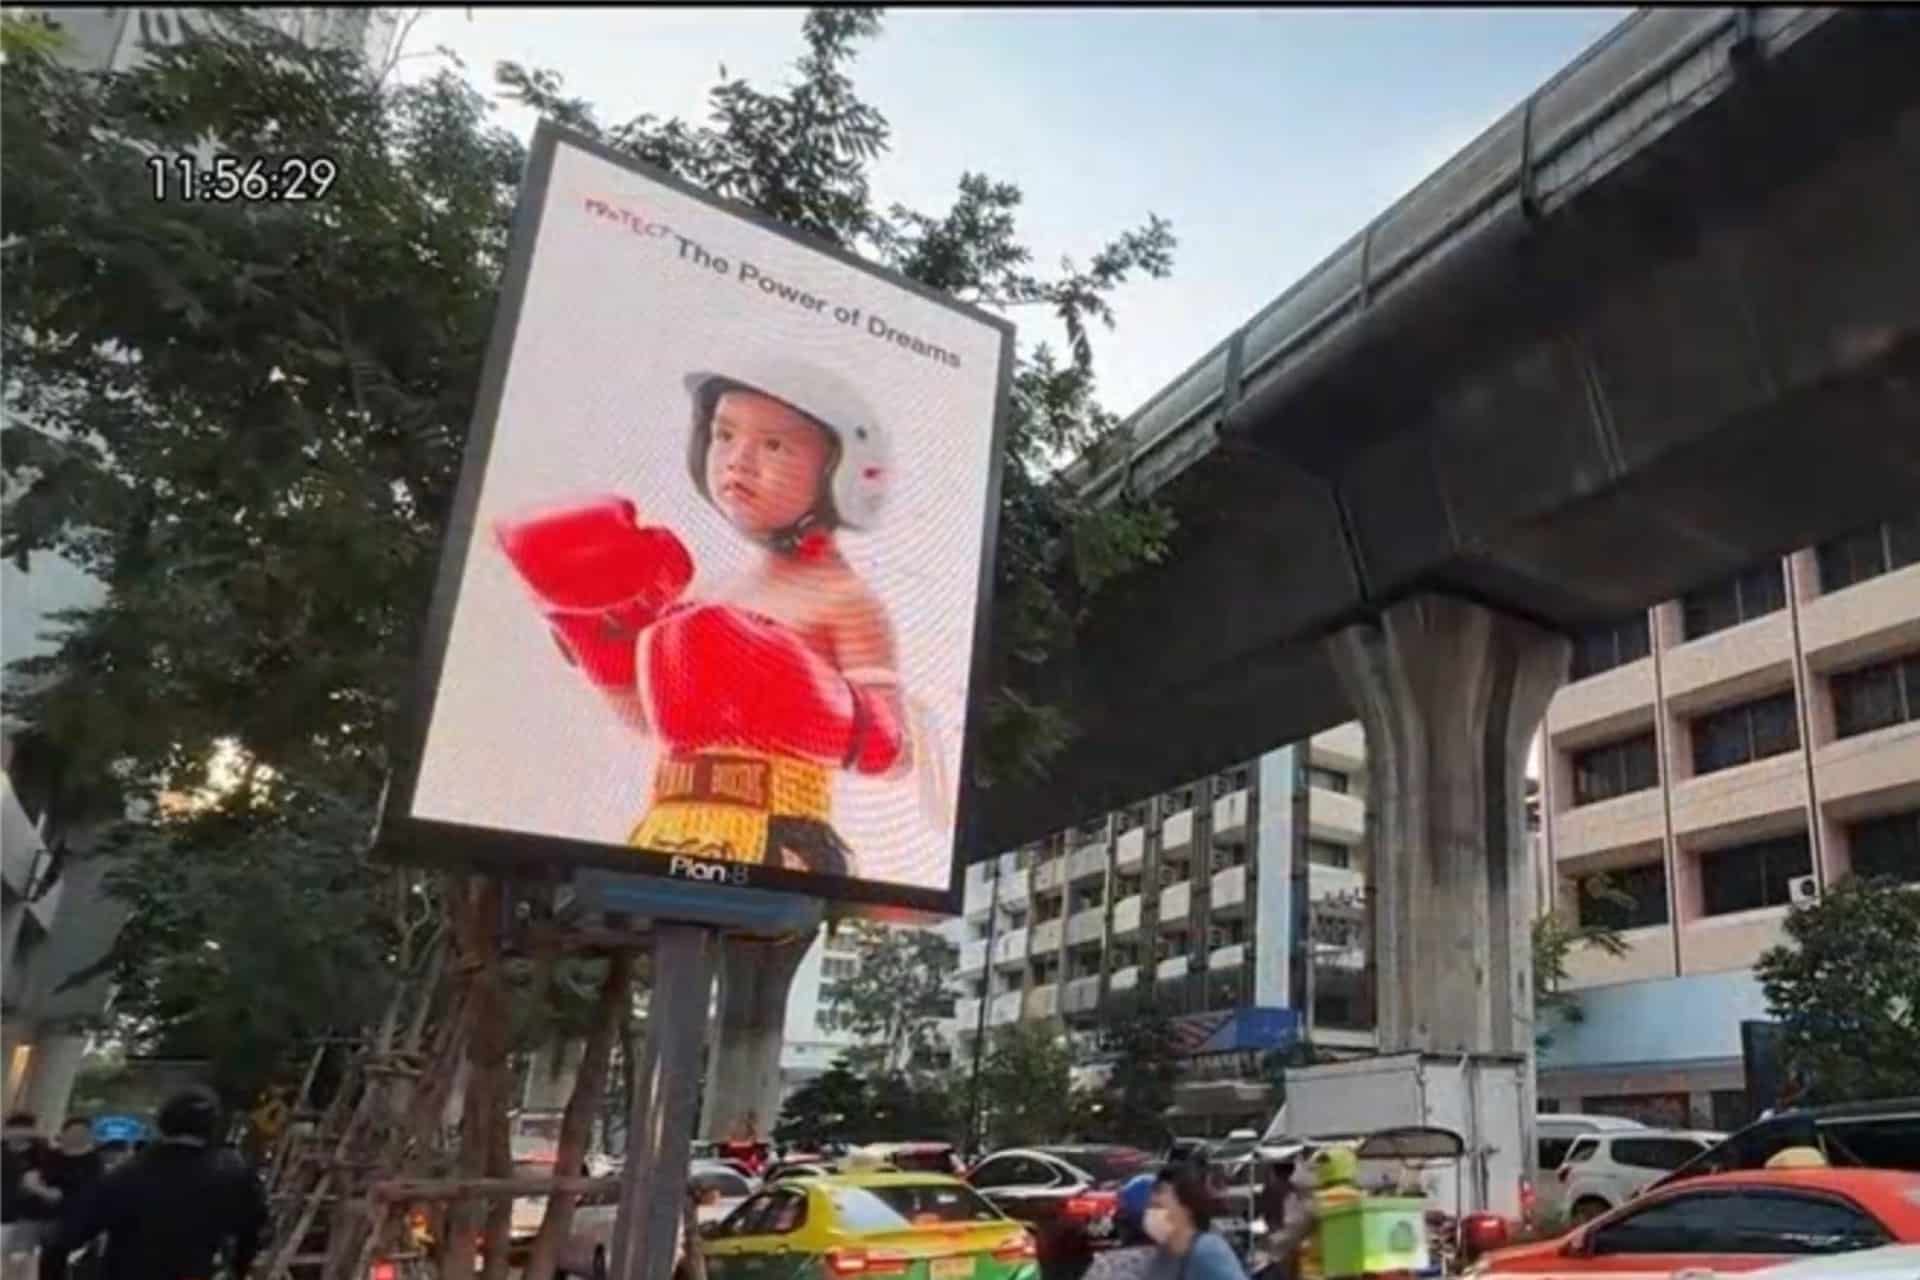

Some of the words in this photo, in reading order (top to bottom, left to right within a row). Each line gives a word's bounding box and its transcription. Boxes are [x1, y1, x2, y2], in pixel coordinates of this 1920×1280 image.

[674, 233, 729, 275] The
[738, 260, 827, 313] Power
[833, 306, 860, 326] of
[867, 315, 961, 368] Dreams
